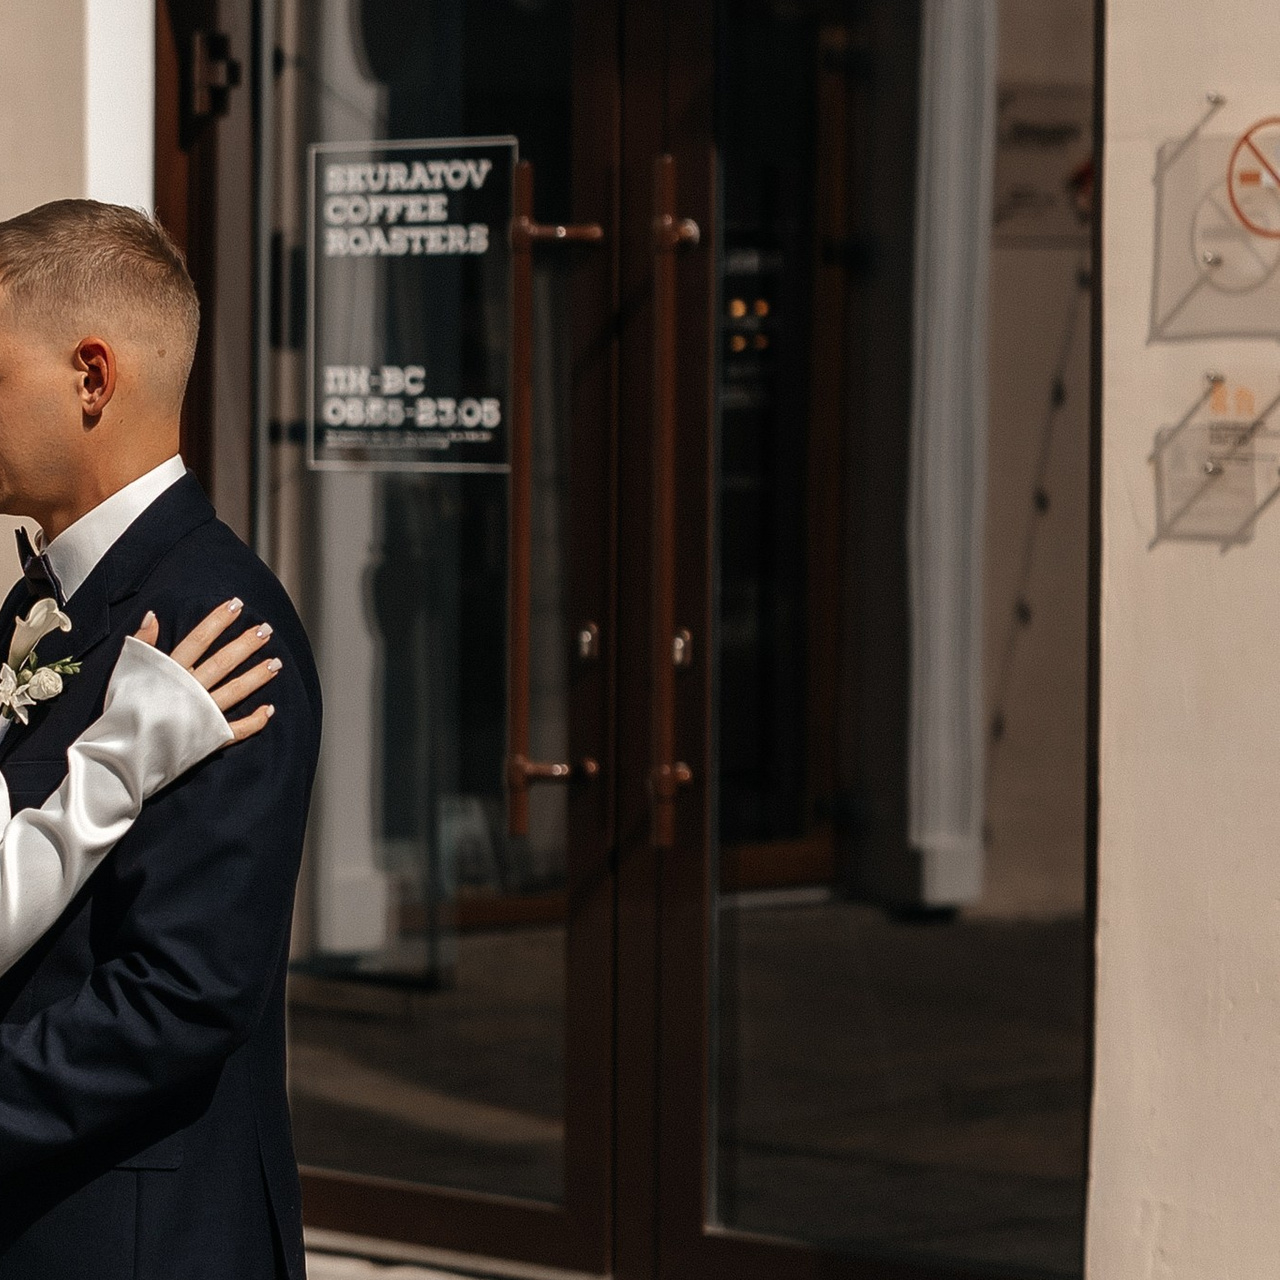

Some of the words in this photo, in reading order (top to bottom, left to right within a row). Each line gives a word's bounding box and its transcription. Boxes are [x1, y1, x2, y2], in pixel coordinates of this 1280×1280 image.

[324, 158, 493, 193] SKURATOV
[324, 192, 450, 225] COFFEE
[324, 223, 489, 256] ROASTERS
